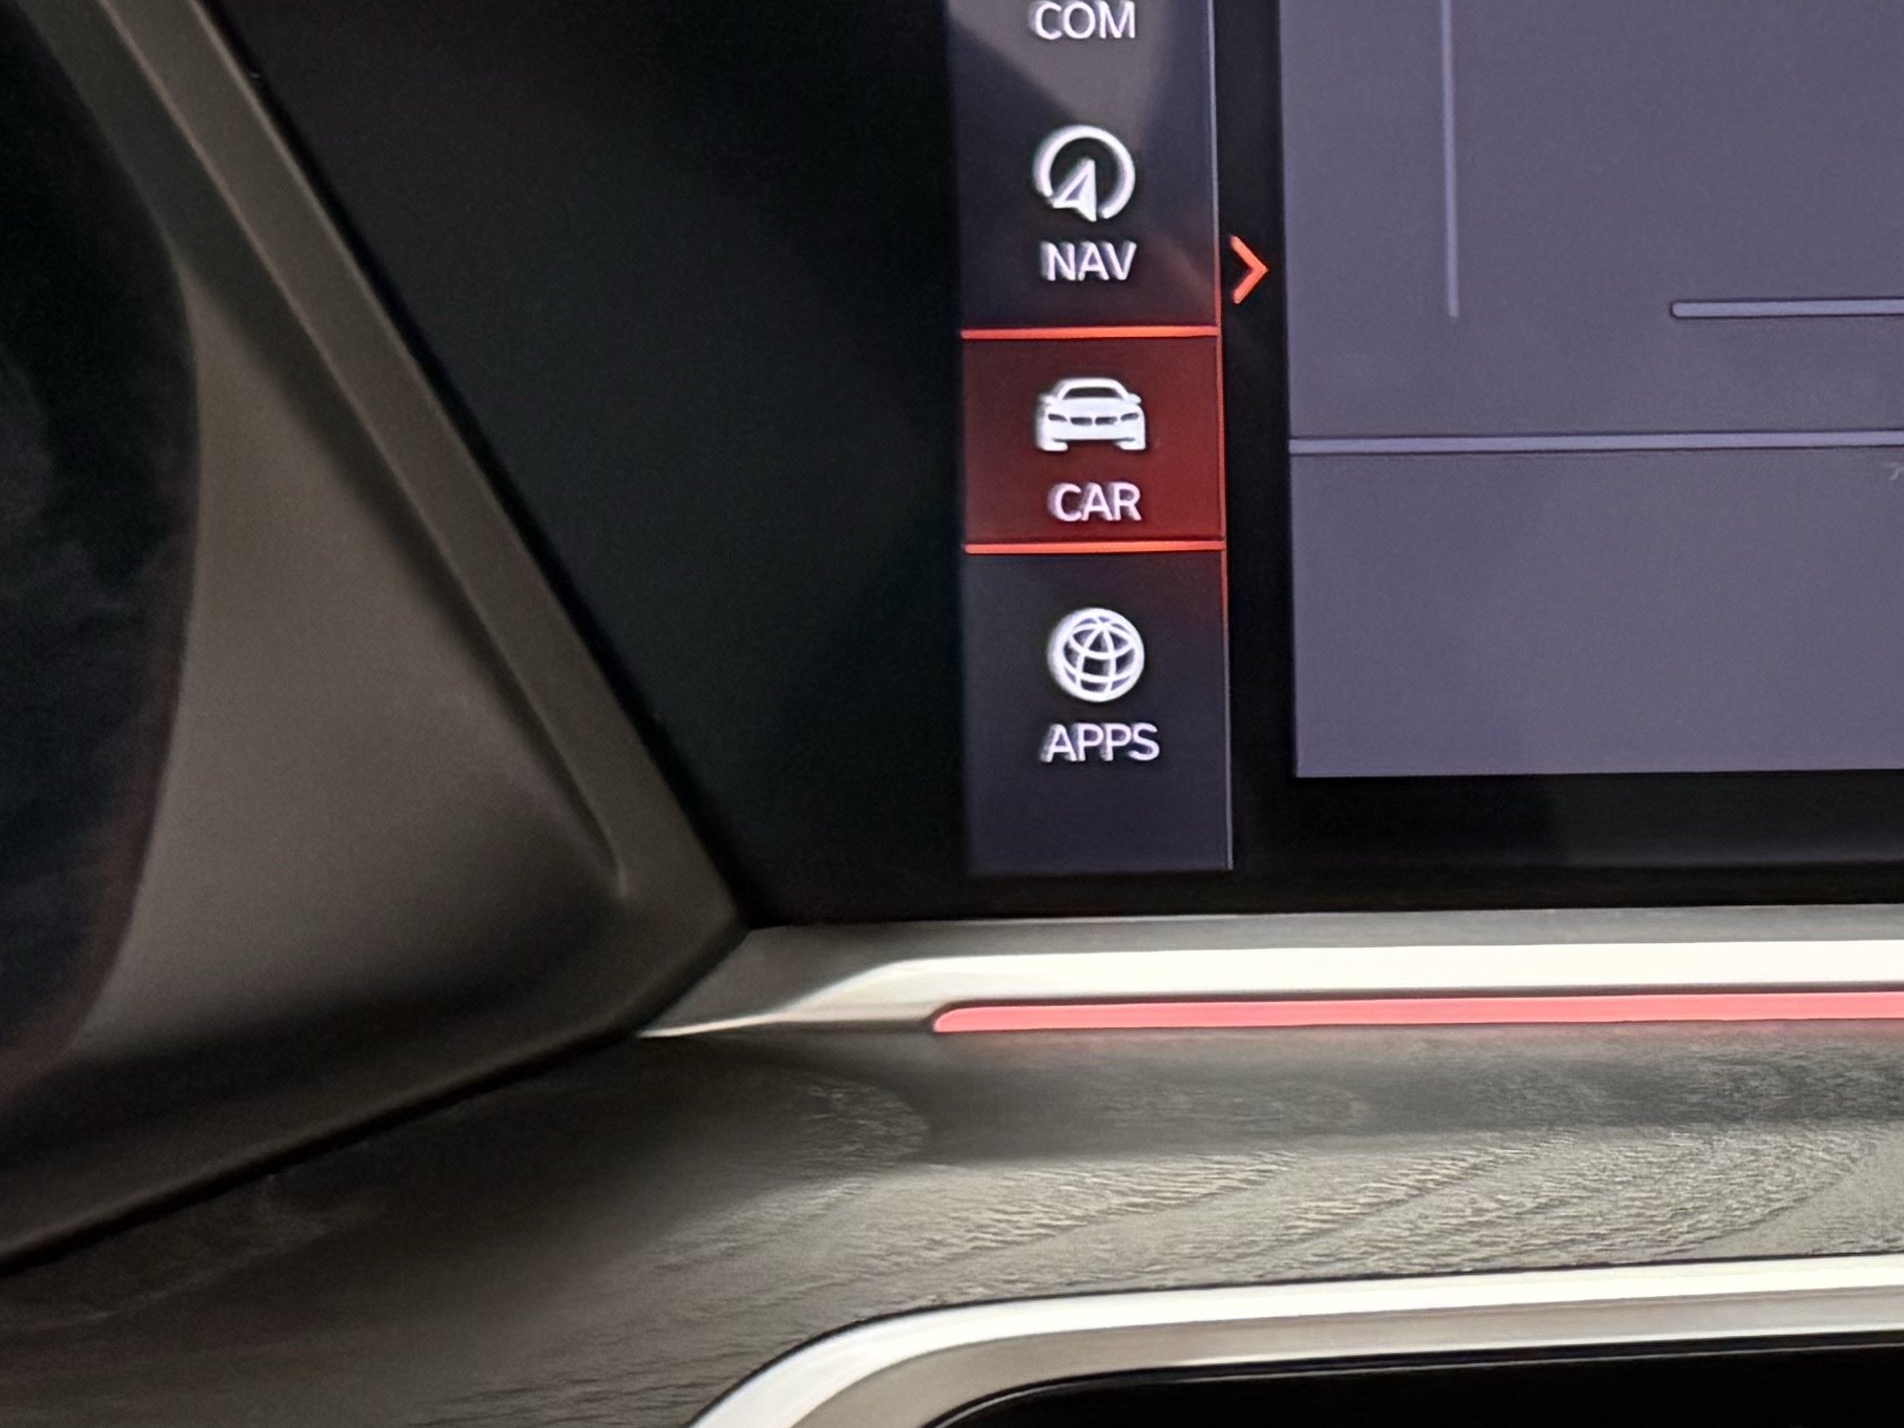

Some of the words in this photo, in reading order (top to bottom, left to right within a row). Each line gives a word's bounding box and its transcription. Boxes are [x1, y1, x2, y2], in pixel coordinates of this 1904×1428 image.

[1032, 0, 1135, 39] COM
[1042, 242, 1136, 280] NAV
[1051, 482, 1141, 521] CAR
[1042, 723, 1159, 762] APPS
